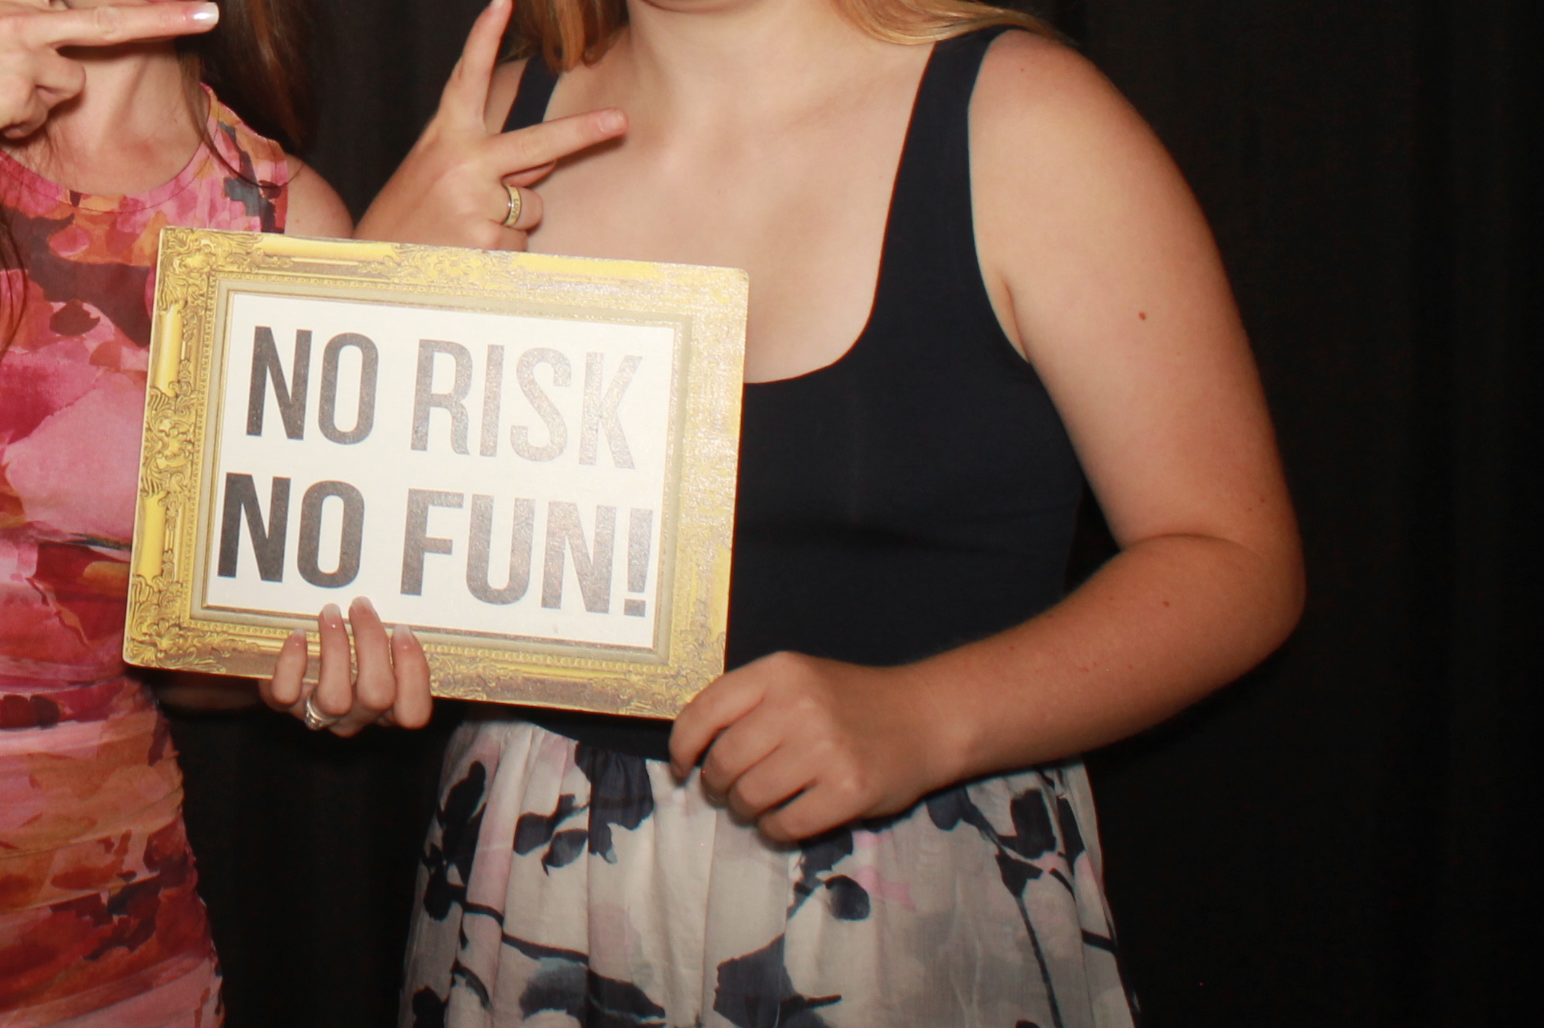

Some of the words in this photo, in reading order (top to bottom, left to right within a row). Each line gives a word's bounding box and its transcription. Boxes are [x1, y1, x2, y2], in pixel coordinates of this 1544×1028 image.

[247, 326, 379, 445] NO
[410, 339, 643, 470] RISK
[217, 472, 365, 589] NO
[400, 488, 653, 617] FUN!
